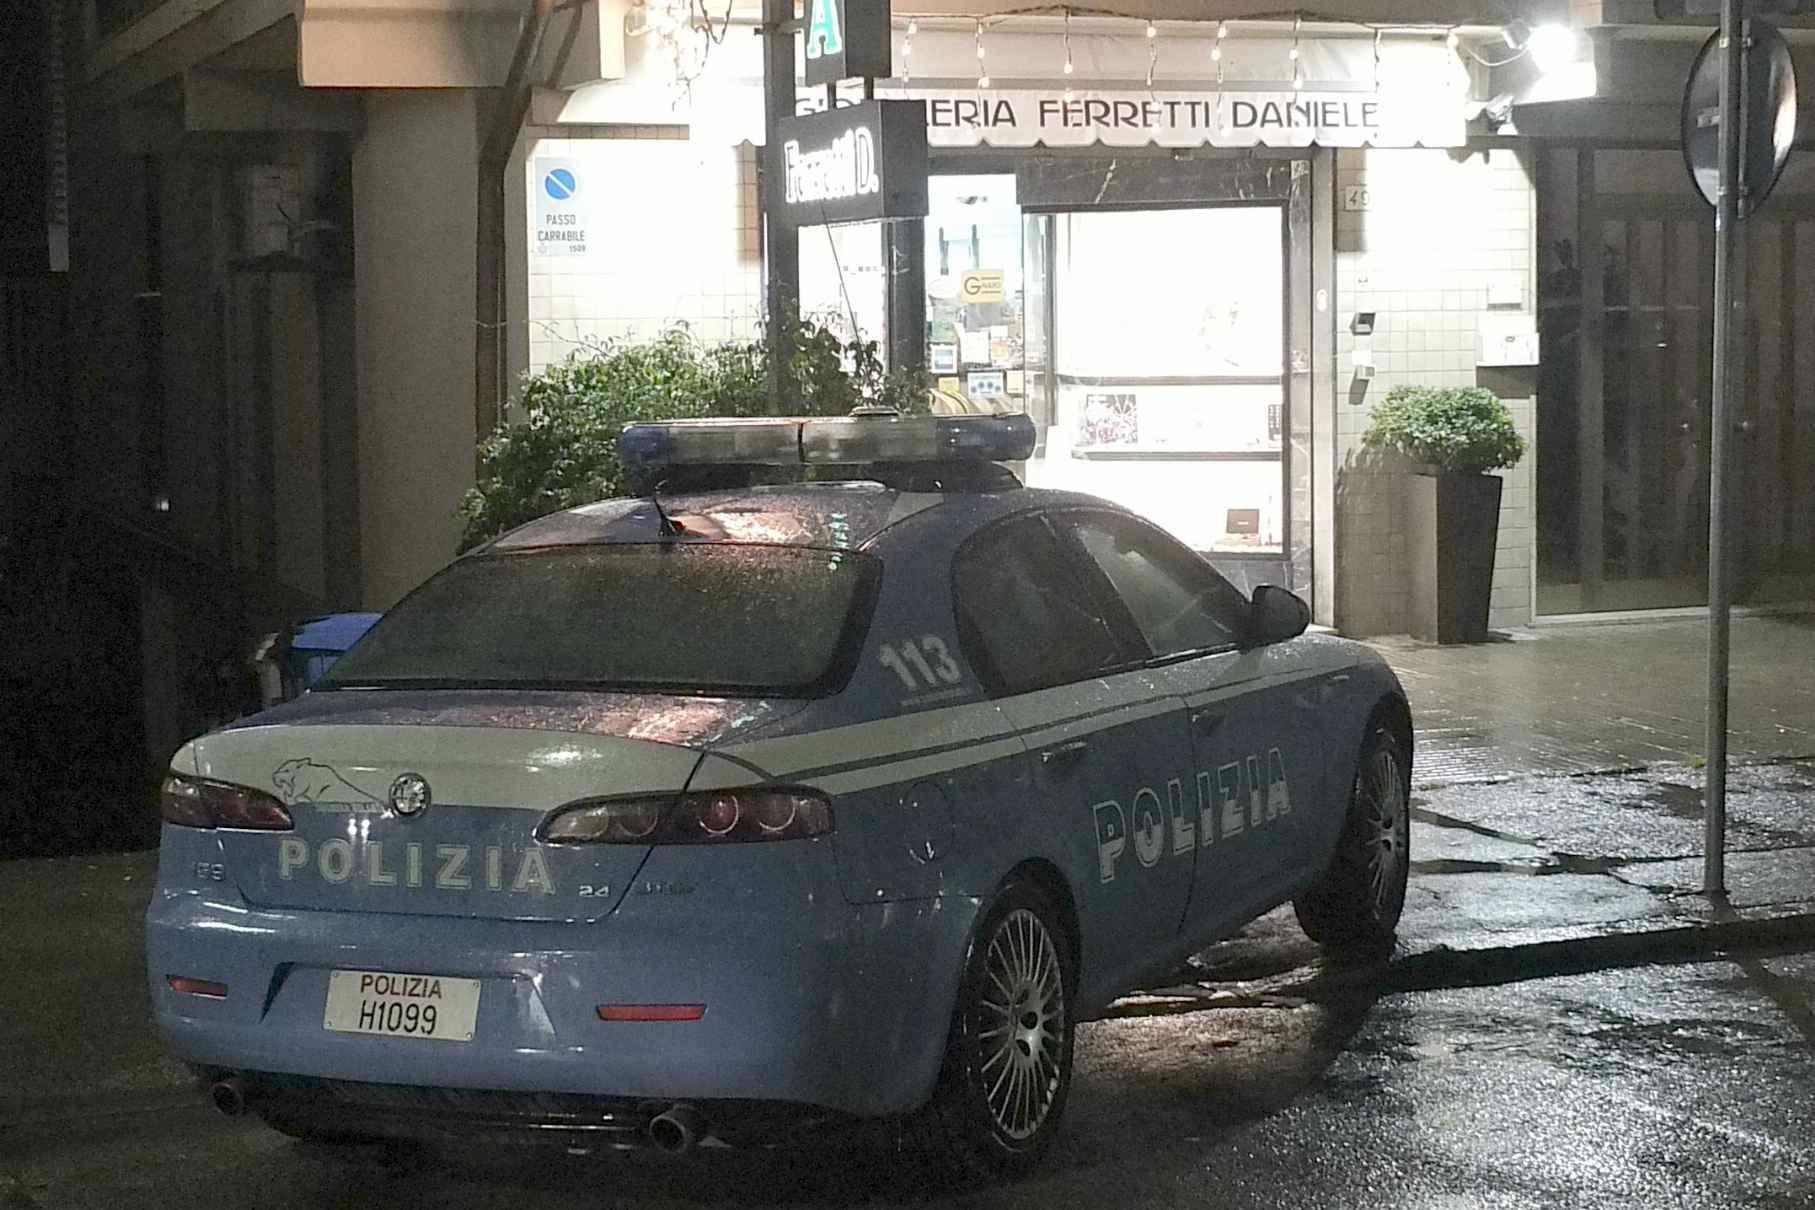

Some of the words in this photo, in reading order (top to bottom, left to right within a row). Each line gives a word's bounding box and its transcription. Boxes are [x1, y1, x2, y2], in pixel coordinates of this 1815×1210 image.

[1039, 99, 1210, 128] FERRETTI
[1231, 100, 1380, 128] DANIELE
[537, 230, 585, 242] CARRABILE
[545, 214, 576, 226] PASSO
[880, 634, 960, 688] 113
[1092, 747, 1293, 885] POLIZIA
[279, 836, 557, 896] POLIZIA
[360, 974, 443, 999] POLIZIA
[358, 1000, 438, 1036] H1099
